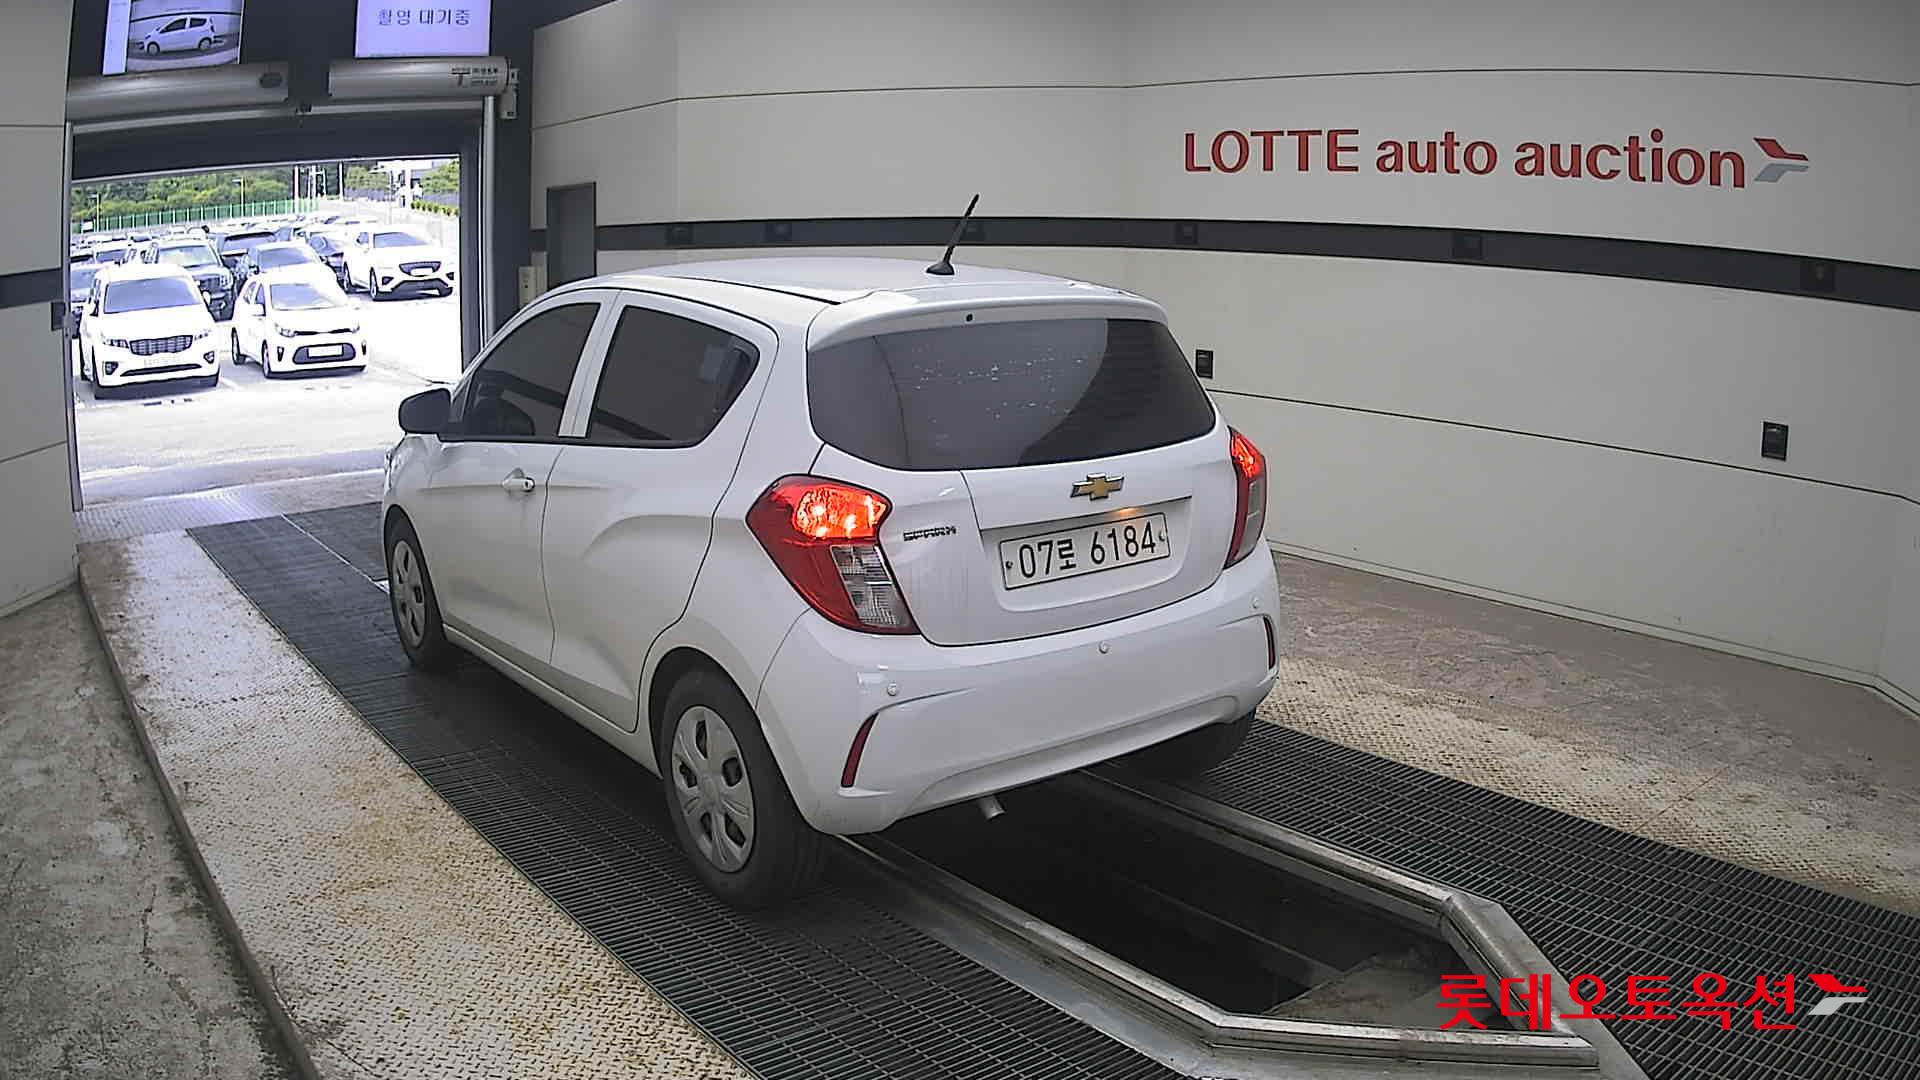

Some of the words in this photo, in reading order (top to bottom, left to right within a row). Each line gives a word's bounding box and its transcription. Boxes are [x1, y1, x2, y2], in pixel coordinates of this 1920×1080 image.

[419, 9, 470, 26] 대기중
[1184, 128, 1359, 173] LOTTE
[1375, 131, 1498, 175] auto
[1513, 128, 1746, 188] auction
[1018, 537, 1077, 579] 07로
[1090, 520, 1157, 565] 6184
